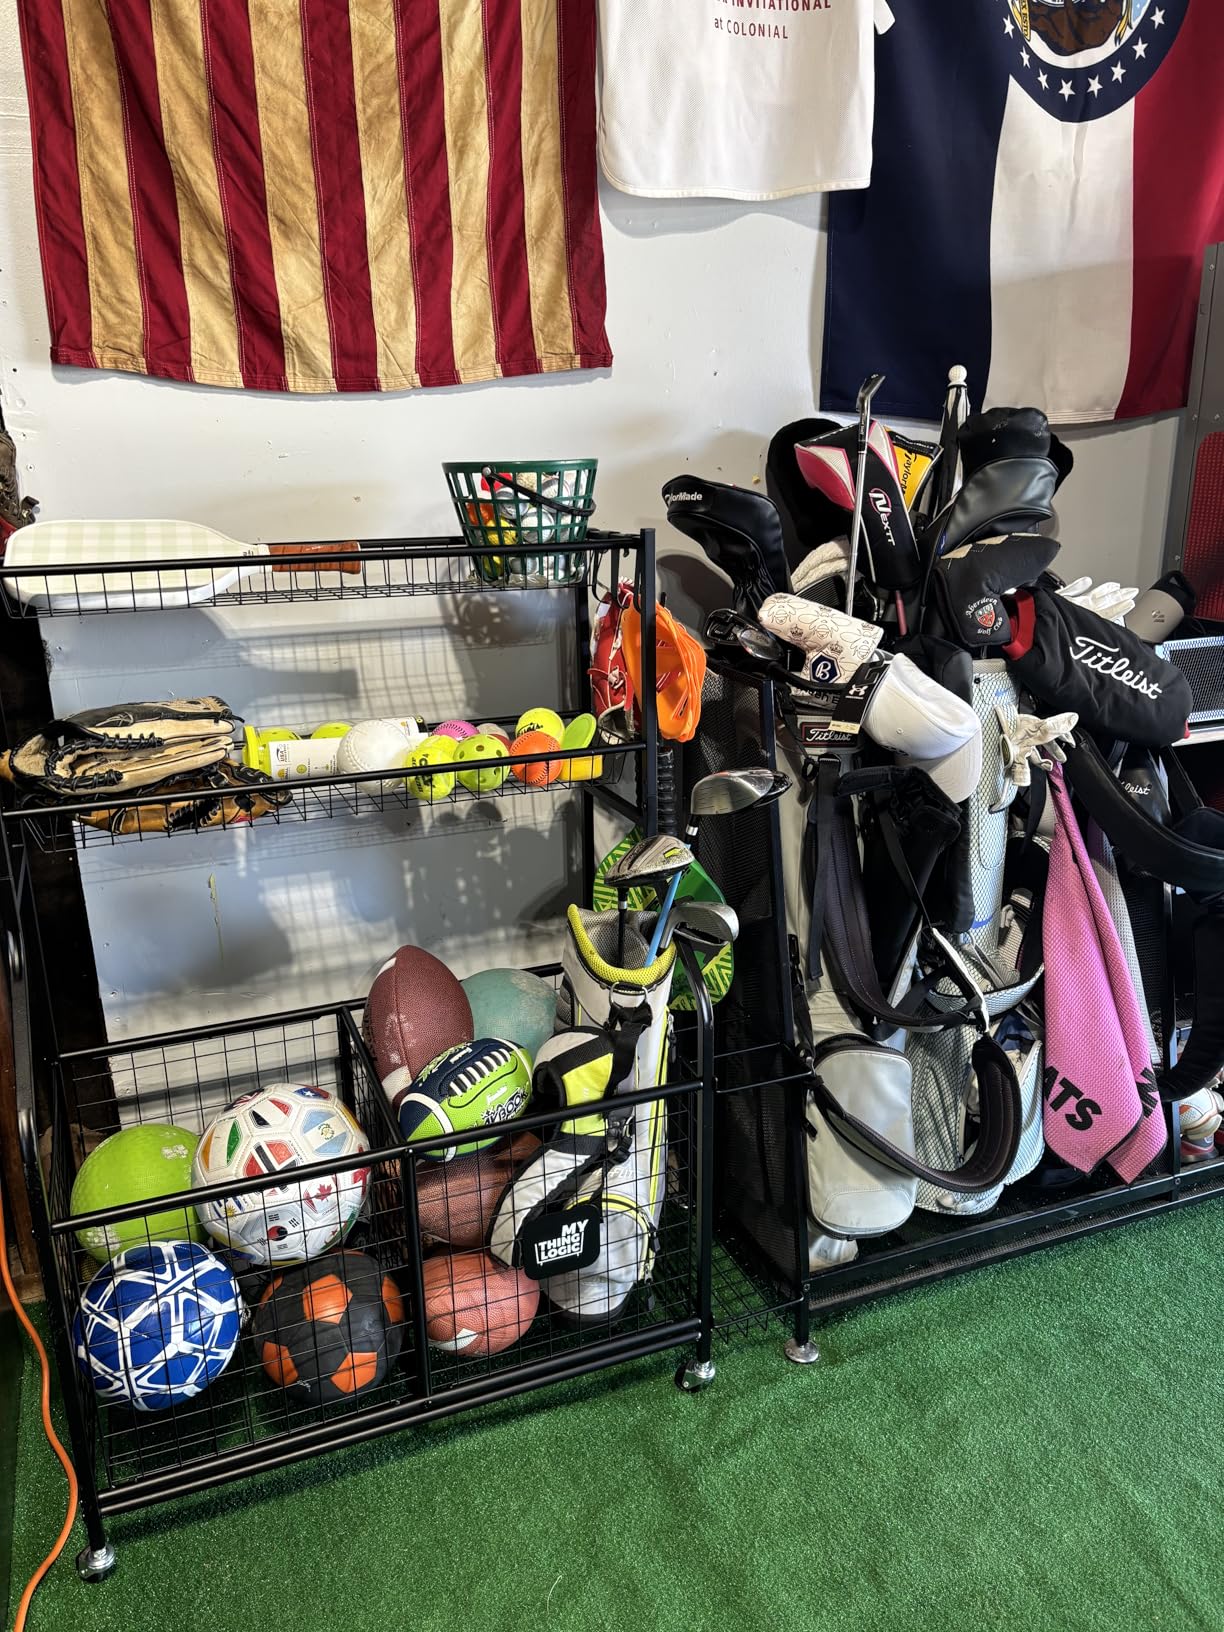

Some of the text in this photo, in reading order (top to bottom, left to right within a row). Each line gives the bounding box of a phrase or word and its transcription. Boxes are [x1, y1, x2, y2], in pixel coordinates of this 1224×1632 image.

[714, 17, 788, 39] at COLONIAL
[1069, 636, 1163, 700] Titleist
[806, 728, 852, 742] Titleist
[1121, 781, 1151, 796] leist
[561, 1218, 589, 1237] MY
[538, 1232, 581, 1251] THING
[540, 1242, 581, 1261] LOGIC
